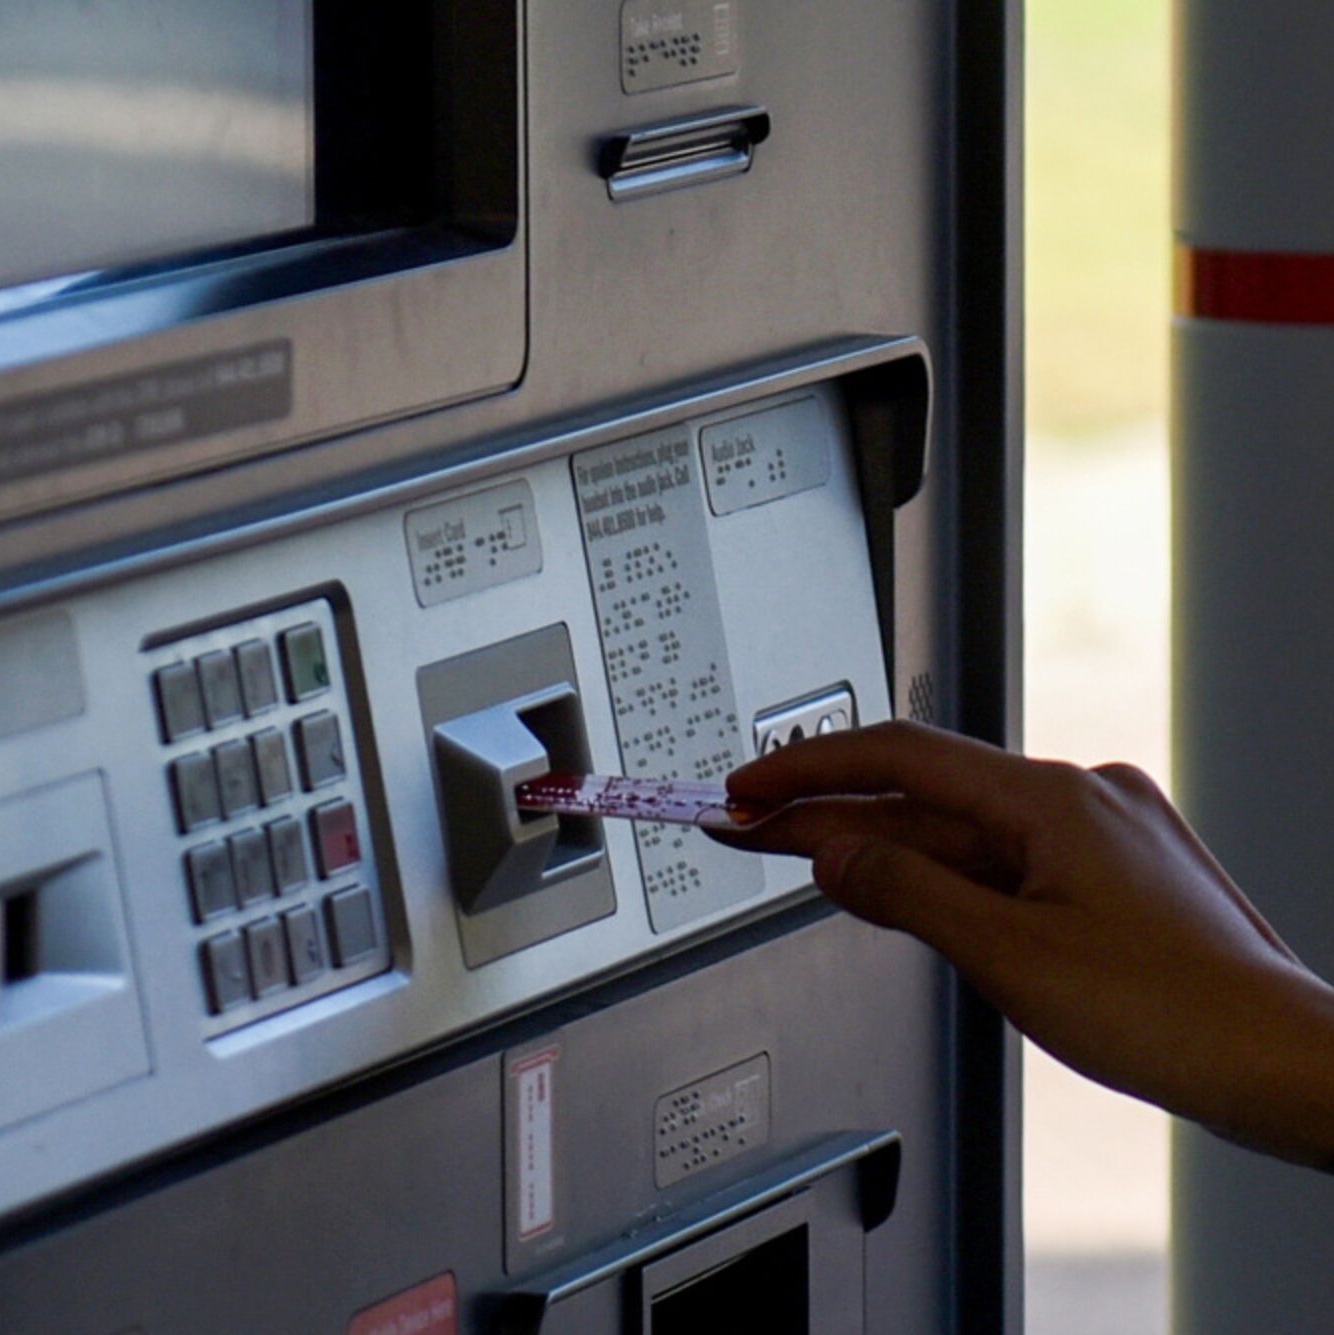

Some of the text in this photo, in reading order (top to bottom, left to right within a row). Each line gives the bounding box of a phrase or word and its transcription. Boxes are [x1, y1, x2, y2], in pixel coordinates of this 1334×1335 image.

[711, 433, 756, 463] Audio Jack
[675, 463, 689, 486] Call
[416, 517, 466, 552] Insert Card
